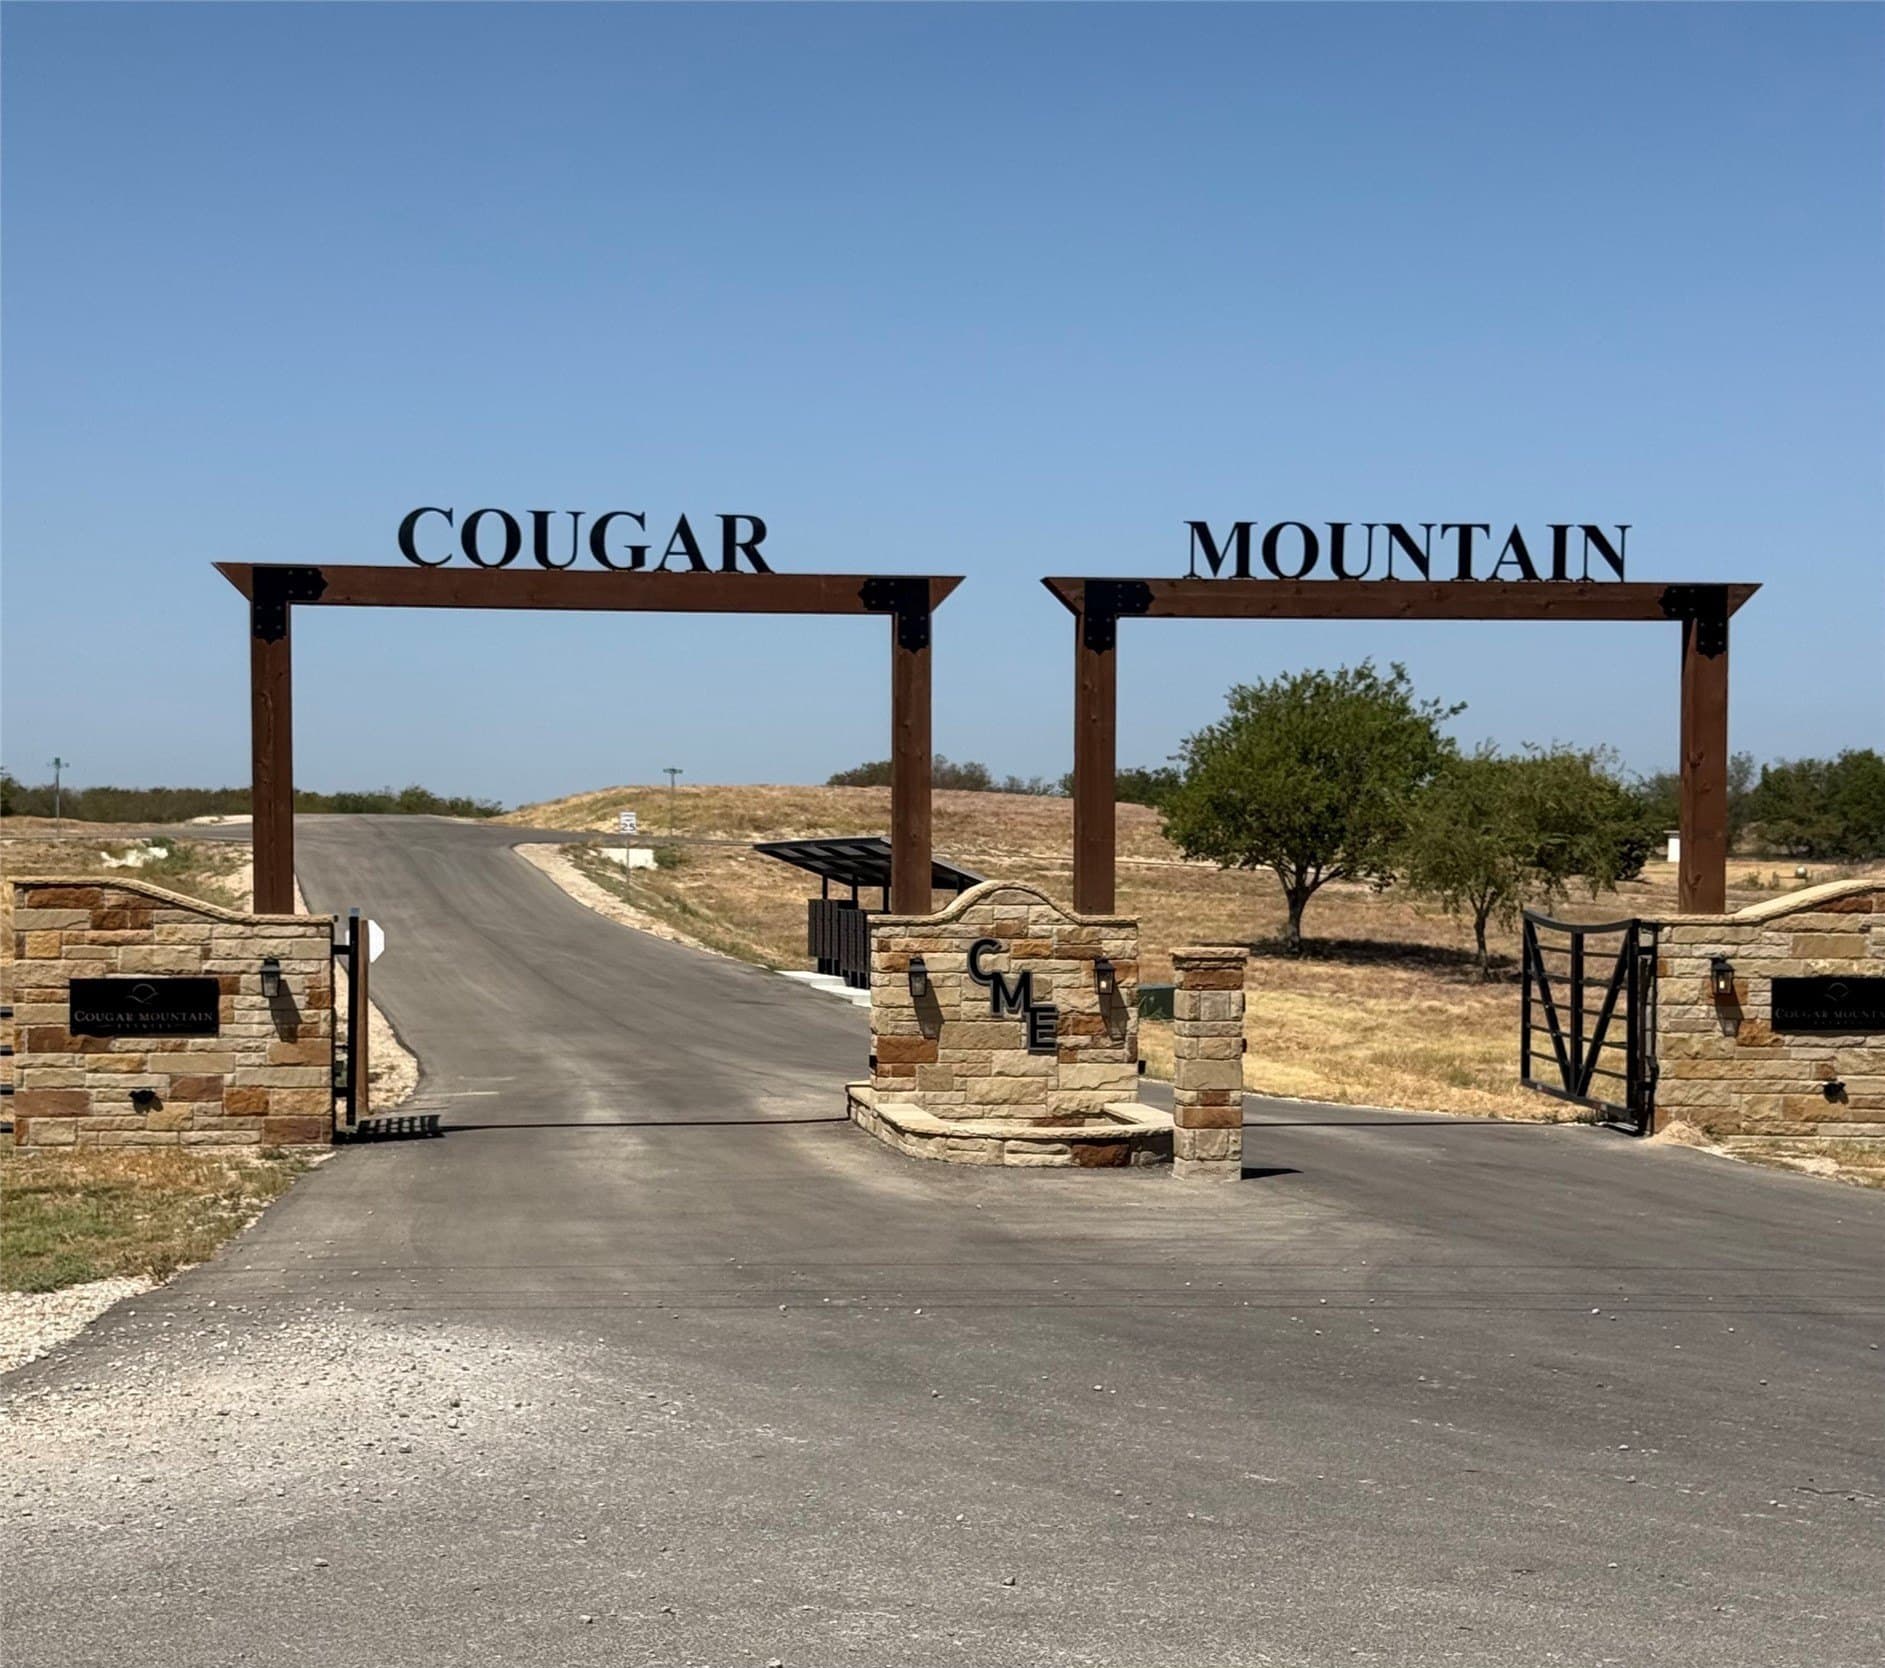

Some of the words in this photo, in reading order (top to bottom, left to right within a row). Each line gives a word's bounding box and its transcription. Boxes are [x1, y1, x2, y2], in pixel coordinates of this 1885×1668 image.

[398, 507, 776, 575] COUGAR
[1184, 521, 1632, 583] MOUNTAIN
[623, 823, 636, 831] 25
[74, 1010, 133, 1022] COUGAR
